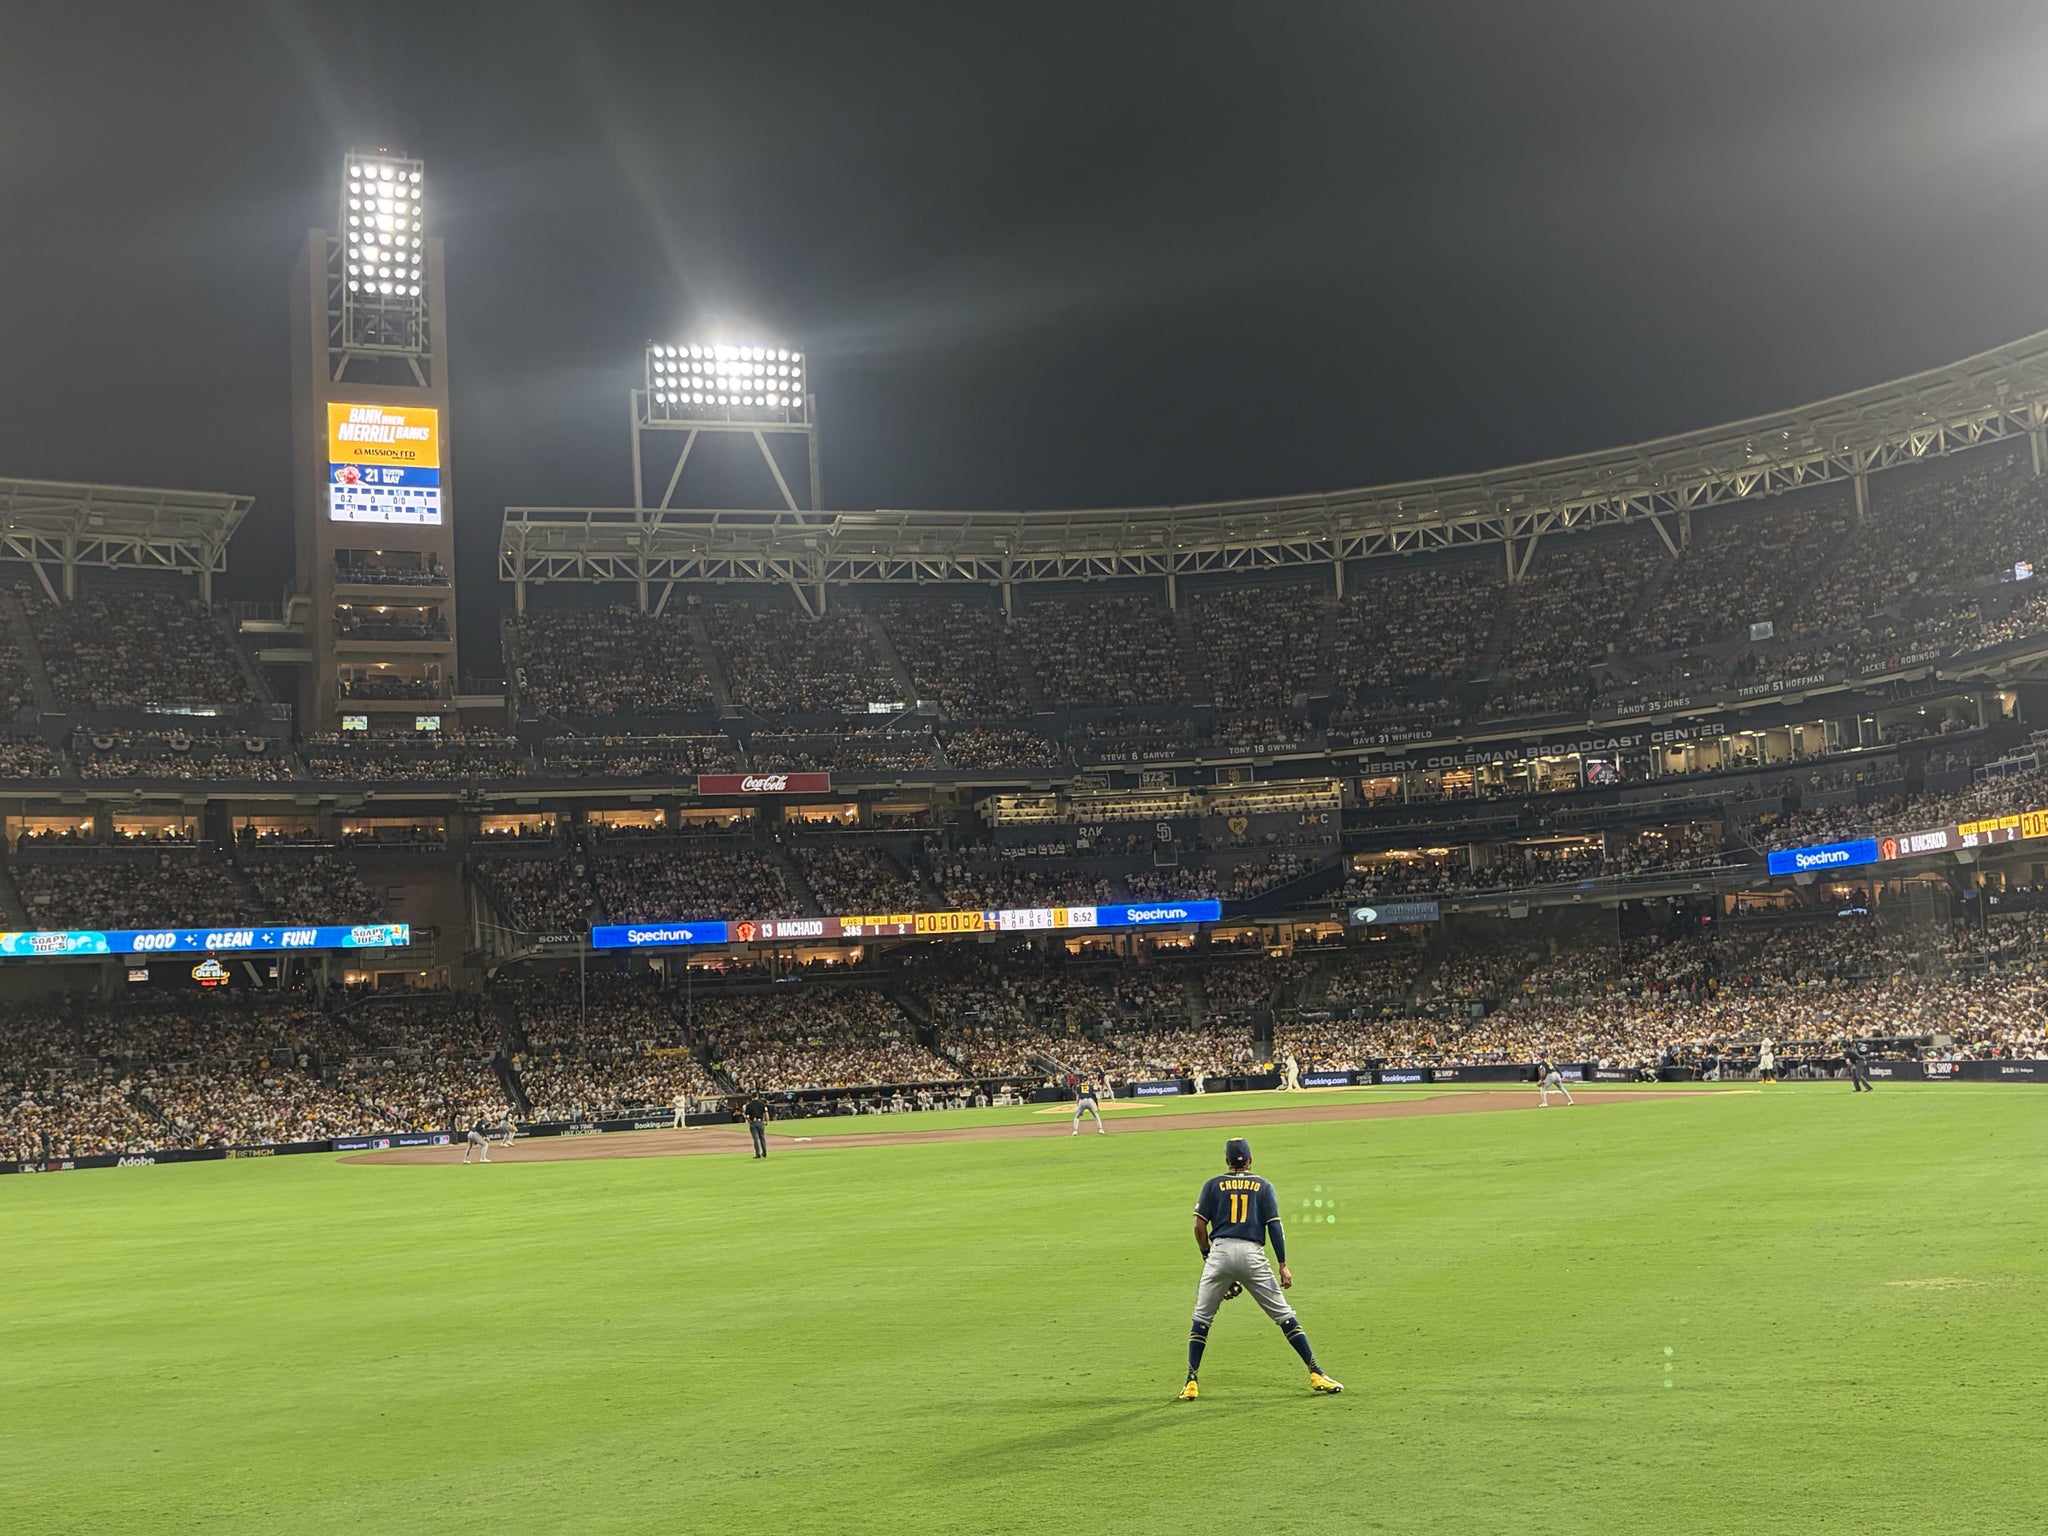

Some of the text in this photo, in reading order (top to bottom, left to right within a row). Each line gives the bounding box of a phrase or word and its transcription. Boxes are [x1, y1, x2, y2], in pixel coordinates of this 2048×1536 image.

[349, 408, 383, 424] BANK
[338, 422, 430, 443] MERRILL BANKS
[364, 448, 415, 458] MISSION FED
[364, 468, 379, 482] 21
[1861, 662, 1886, 674] JACKIE
[1901, 650, 1940, 665] ROBINSON
[1738, 674, 1825, 697] TREVOR 51 HOFFMAN
[1618, 698, 1690, 716] RANDY 35 JONES
[1353, 731, 1432, 745] DAVE 31 WINFIELD
[1229, 743, 1297, 755] TONY 19 GWYNN
[1360, 723, 1725, 774] JERRY COLEMAN BROADCAST CENTER
[1101, 751, 1175, 761] STEVE 6 GARVEY
[741, 775, 788, 791] Coca-Cola
[1079, 827, 1103, 837] RAK
[1986, 831, 1993, 843] 1
[2007, 828, 2014, 840] 2
[1900, 831, 1948, 853] 13 MACHADO
[1796, 851, 1847, 869] Spectrum
[973, 913, 982, 929] 2
[1073, 912, 1092, 922] 6:52
[1127, 908, 1185, 921] Spectrum
[353, 927, 384, 938] SOAPY
[761, 921, 823, 937] 13 MACHADO
[843, 924, 905, 937] .385 1 2
[31, 935, 67, 945] SOAPY
[133, 929, 317, 950] GOOD CLEAN FUN!
[538, 935, 570, 943] SONY
[628, 929, 690, 944] Spectrum
[35, 942, 66, 952] JOE'S
[1937, 1063, 1952, 1074] SHOP
[1305, 1077, 1347, 1086] Booking.com
[1382, 1074, 1421, 1083] Booking.com
[1081, 1085, 1090, 1093] 12
[1138, 1086, 1178, 1095] Booking.com
[634, 1120, 675, 1130] Booking.com
[117, 1155, 156, 1167] Adobe
[1219, 1179, 1261, 1192] CHOURIO
[1230, 1194, 1248, 1223] 11
